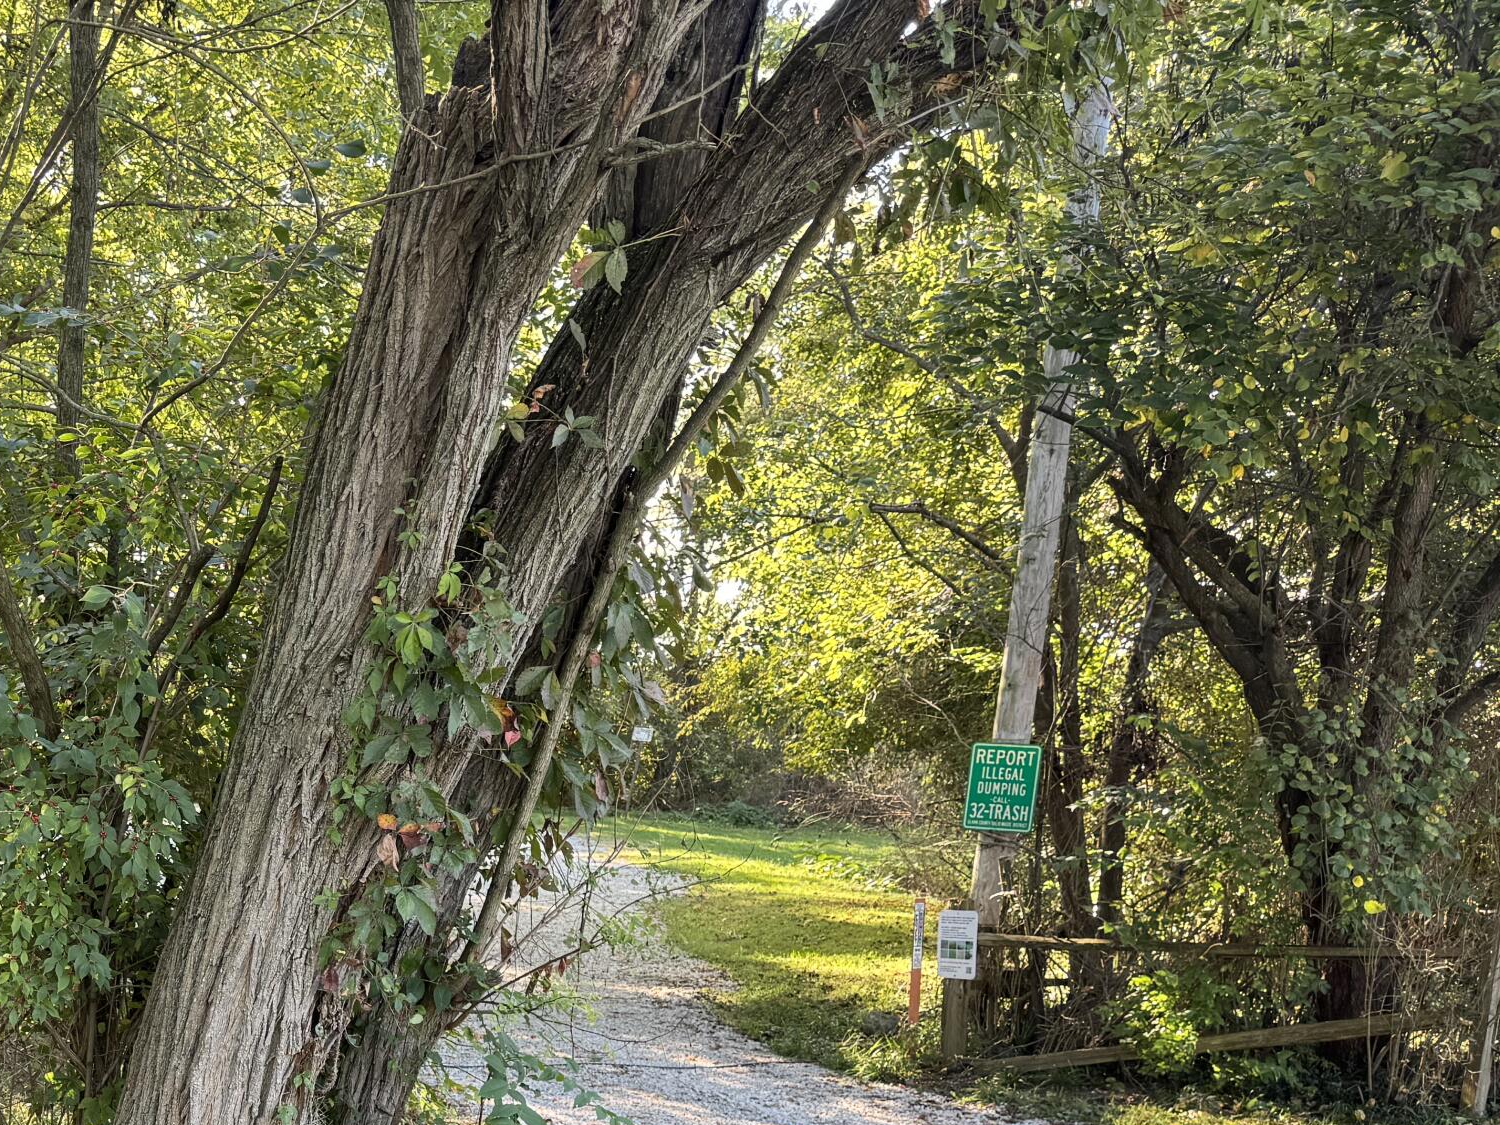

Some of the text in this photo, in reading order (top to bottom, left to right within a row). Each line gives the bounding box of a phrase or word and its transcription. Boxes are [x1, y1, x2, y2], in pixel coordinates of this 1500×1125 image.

[975, 748, 1037, 766] REPORT
[981, 766, 1025, 781] ILLEGAL
[977, 781, 1027, 797] DUMPING
[969, 802, 1029, 822] 32-TRASH
